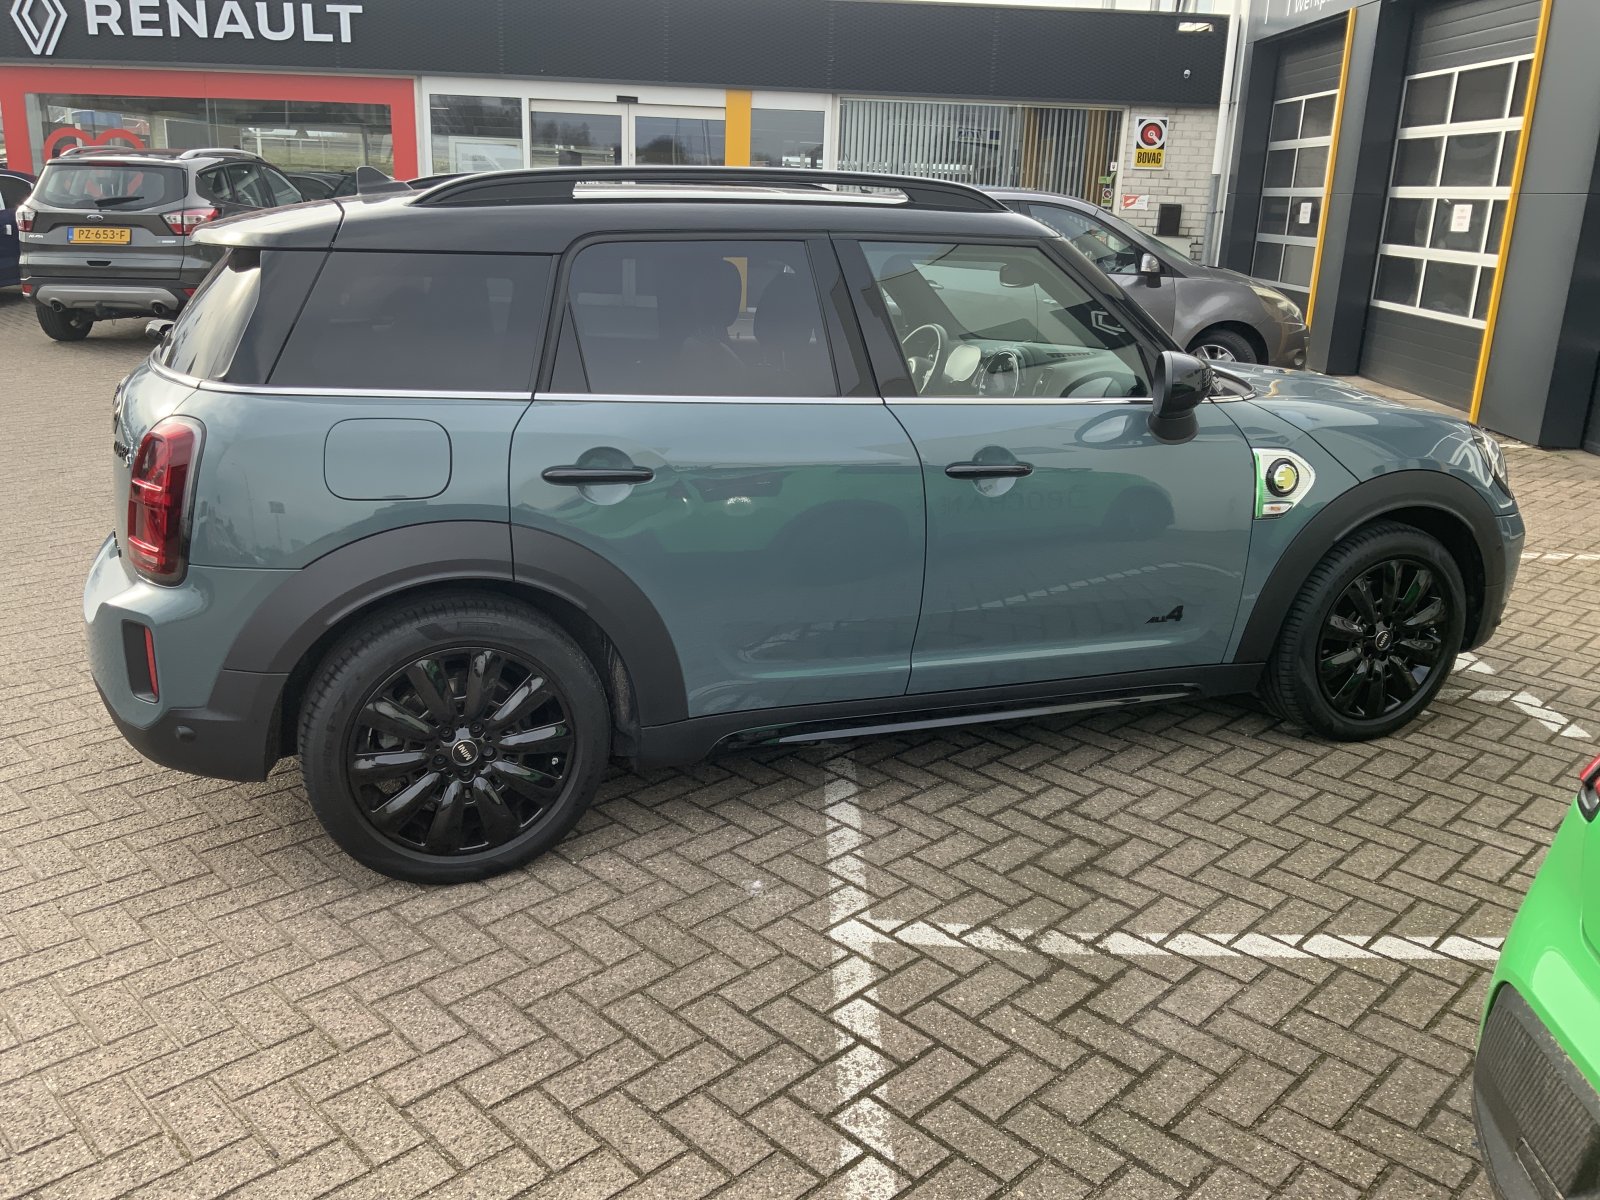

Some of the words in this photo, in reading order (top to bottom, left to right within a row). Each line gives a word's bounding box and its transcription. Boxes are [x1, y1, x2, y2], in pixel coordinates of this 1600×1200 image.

[1294, 0, 1334, 13] Werp
[84, 0, 363, 43] RENAULT
[1136, 151, 1162, 164] BOVAG
[78, 227, 126, 240] PZ-653-F
[457, 743, 472, 761] MINI
